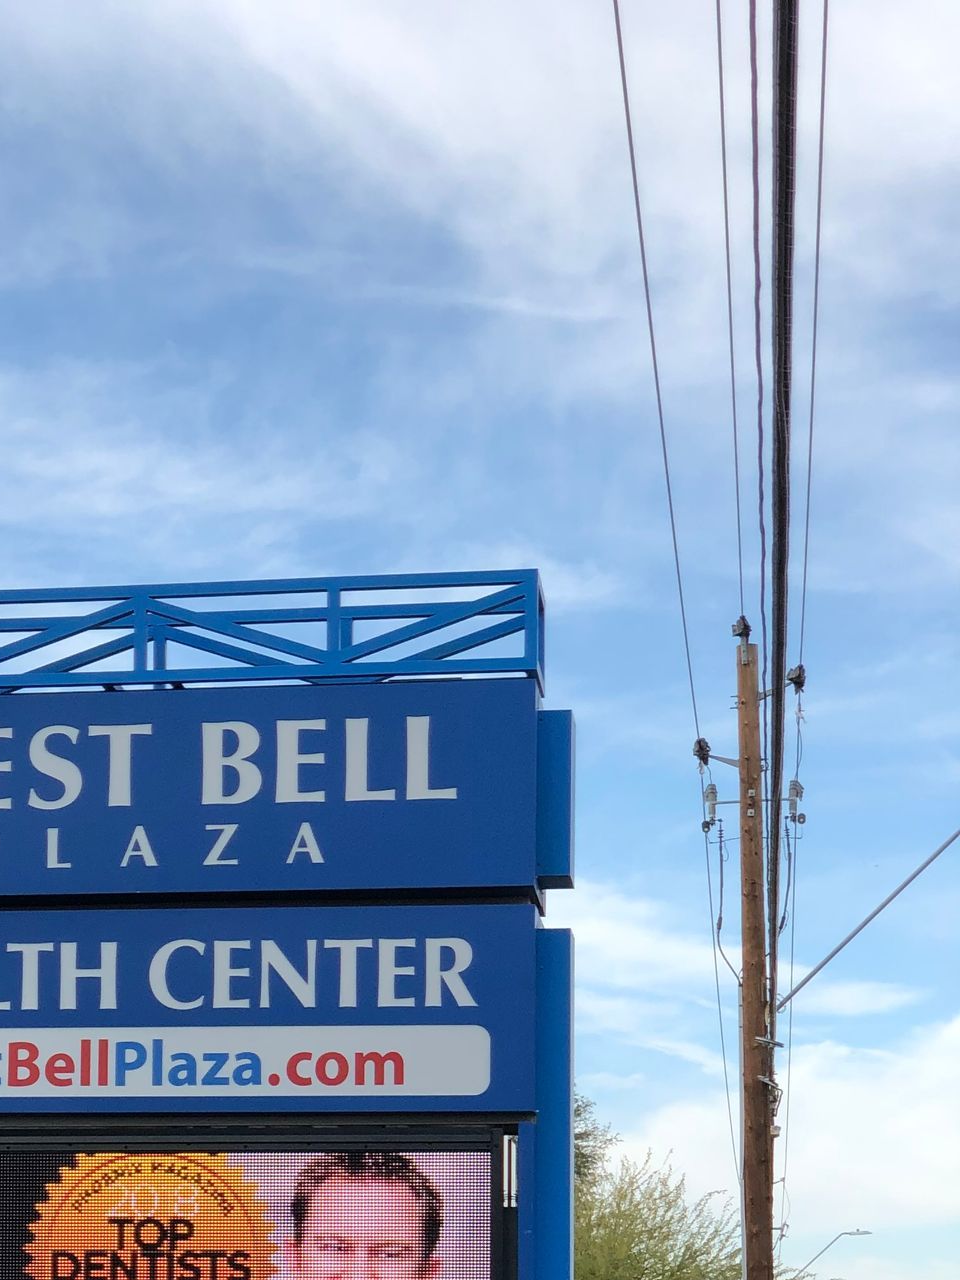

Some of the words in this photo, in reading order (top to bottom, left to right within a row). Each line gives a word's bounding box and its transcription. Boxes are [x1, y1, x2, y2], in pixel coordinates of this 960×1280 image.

[201, 715, 457, 806] BELL
[148, 937, 478, 1010] CENTER
[106, 1182, 200, 1217] 208
[108, 1217, 195, 1251] TOP
